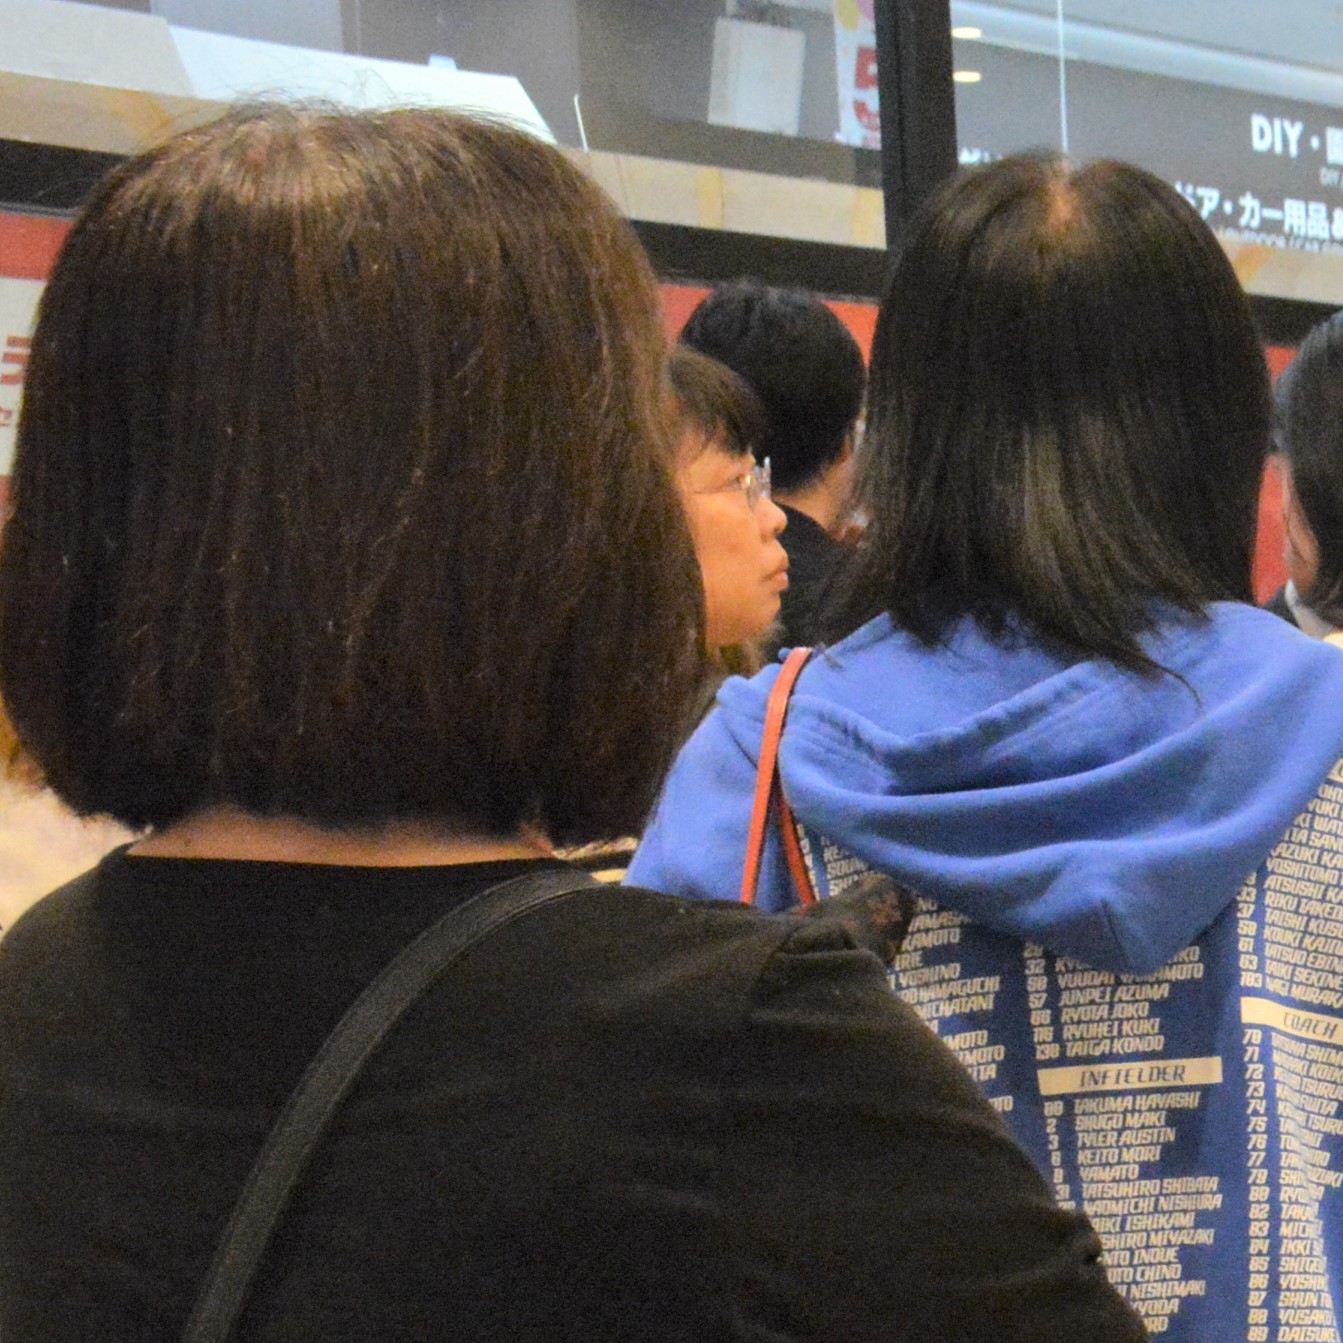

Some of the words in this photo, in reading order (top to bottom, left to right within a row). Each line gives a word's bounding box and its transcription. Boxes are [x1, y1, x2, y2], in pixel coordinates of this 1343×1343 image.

[1264, 891, 1298, 910] RIKU
[1237, 903, 1256, 918] 37
[1114, 983, 1170, 1001] AZUMA
[1121, 1017, 1160, 1036] KUKI
[1283, 1012, 1339, 1040] COACH
[1065, 1039, 1111, 1058] TAIGA
[1079, 1065, 1186, 1088] INFIELDER
[1245, 1064, 1264, 1080] 72
[1246, 1081, 1266, 1097] 73
[1074, 1095, 1133, 1114] TAKUMA
[1135, 1091, 1201, 1110] HAYASHI
[1246, 1099, 1266, 1114] 74
[1046, 1118, 1057, 1133] 2
[1075, 1113, 1123, 1132] SHUGO
[1124, 1110, 1167, 1128] MAKI
[1247, 1117, 1268, 1132] 75
[1048, 1134, 1058, 1150] 3
[1077, 1130, 1118, 1148] TYLER
[1118, 1127, 1176, 1146] AUSTIN
[1247, 1134, 1268, 1149] 76
[1077, 1147, 1119, 1165] KEITO
[1121, 1145, 1162, 1162] MORI
[1247, 1151, 1267, 1167] 77
[1079, 1164, 1139, 1182] YAMATO
[1247, 1169, 1268, 1184] 79
[1082, 1179, 1161, 1199] TATSUHIRO
[1125, 1212, 1195, 1230] ISHIKAMI
[1149, 1229, 1215, 1246] MIYAZAKI
[1133, 1247, 1180, 1264] INOUE
[1135, 1264, 1182, 1282] CHINO
[1278, 1291, 1317, 1308] SHUN
